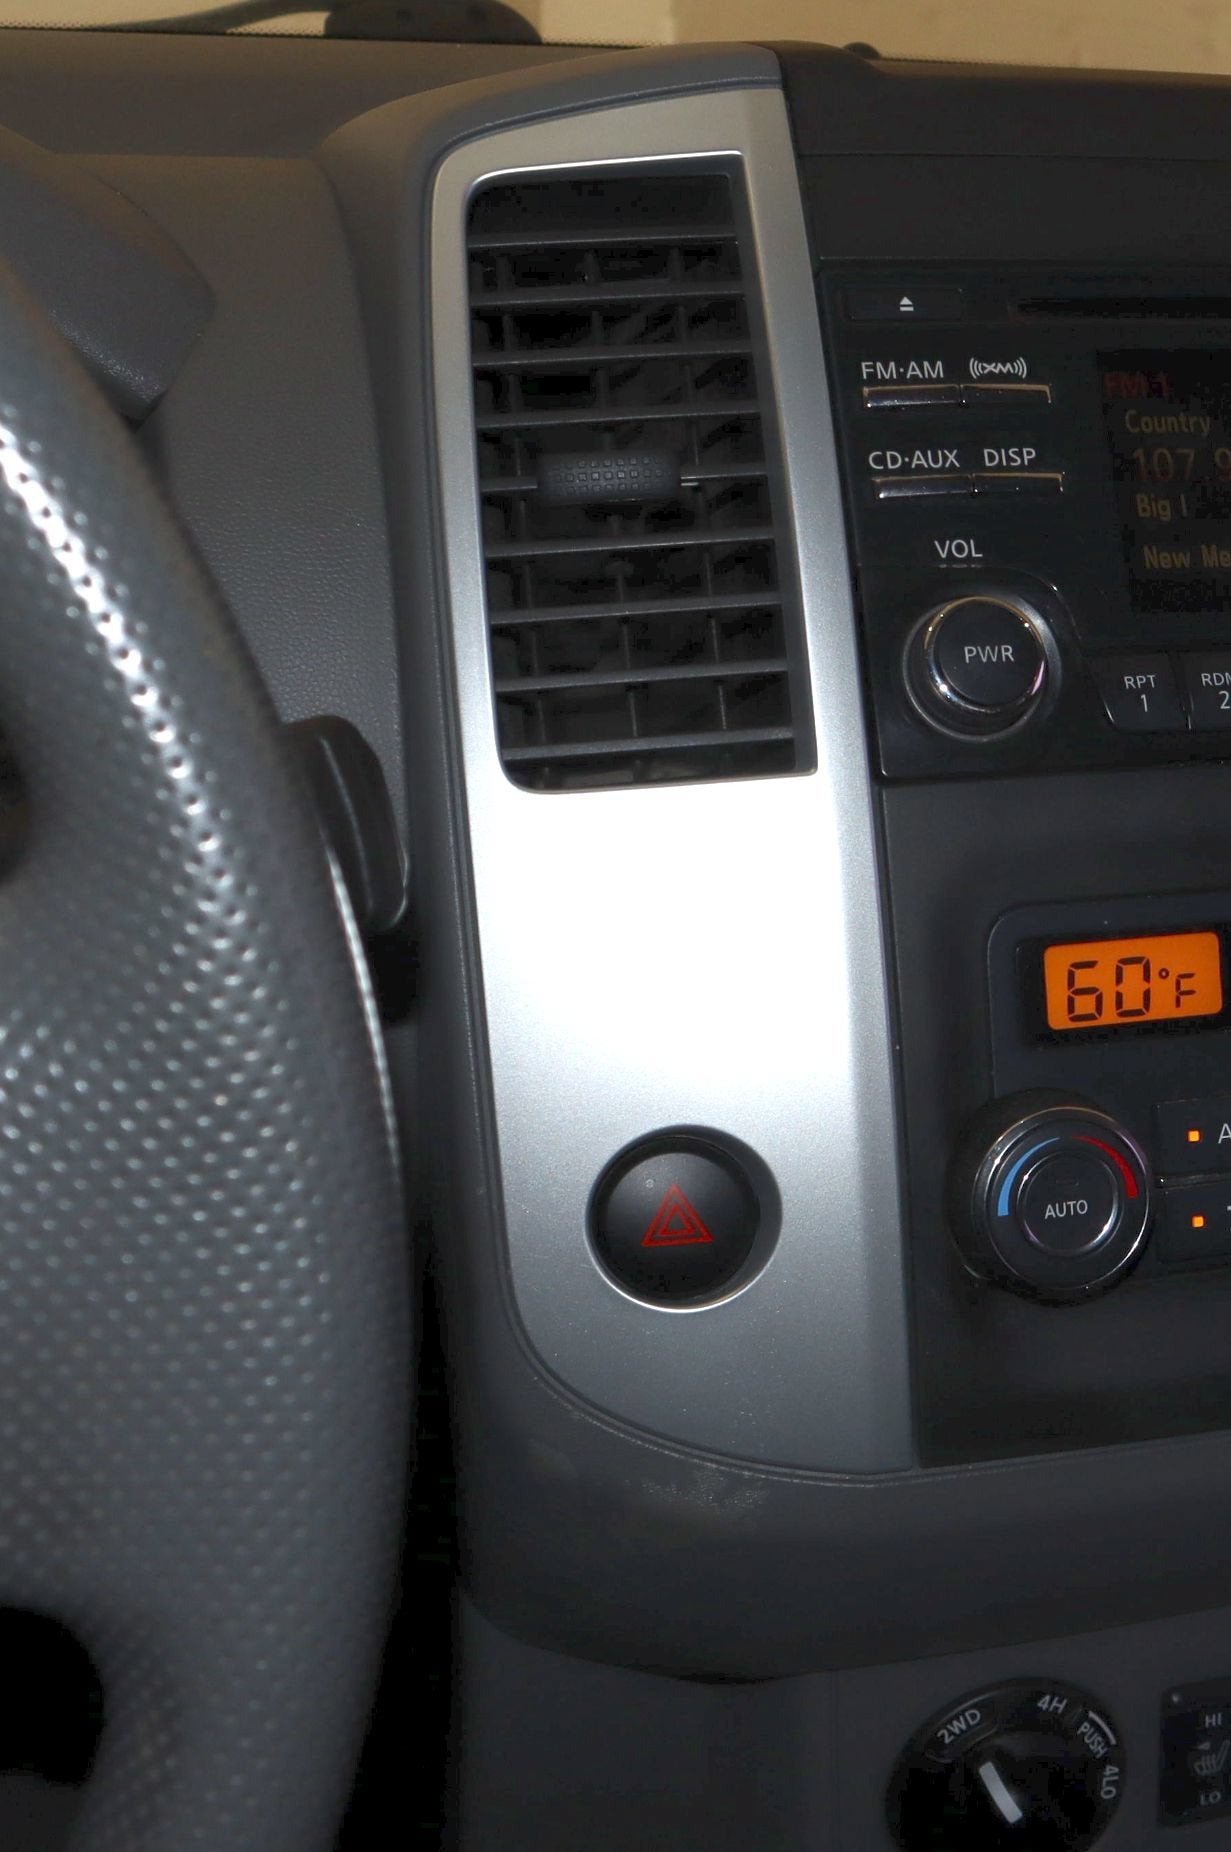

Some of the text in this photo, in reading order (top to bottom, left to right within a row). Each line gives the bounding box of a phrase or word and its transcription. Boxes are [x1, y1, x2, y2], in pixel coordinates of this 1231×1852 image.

[1125, 408, 1212, 438] Country
[983, 447, 1037, 468] DISP
[1136, 493, 1172, 521] Big
[933, 538, 984, 559] VOL
[1143, 545, 1191, 569] New
[963, 643, 1015, 664] PWR
[1123, 674, 1157, 690] RPT
[1140, 693, 1149, 713] 1
[1218, 690, 1231, 710] 2
[1044, 1199, 1089, 1220] AUTO
[1036, 1695, 1068, 1714] 4H
[936, 1708, 982, 1744] 2WD
[1204, 1712, 1222, 1728] HI
[1076, 1721, 1108, 1759] PUSH
[1099, 1764, 1120, 1800] 4LO
[1200, 1790, 1222, 1806] LO
